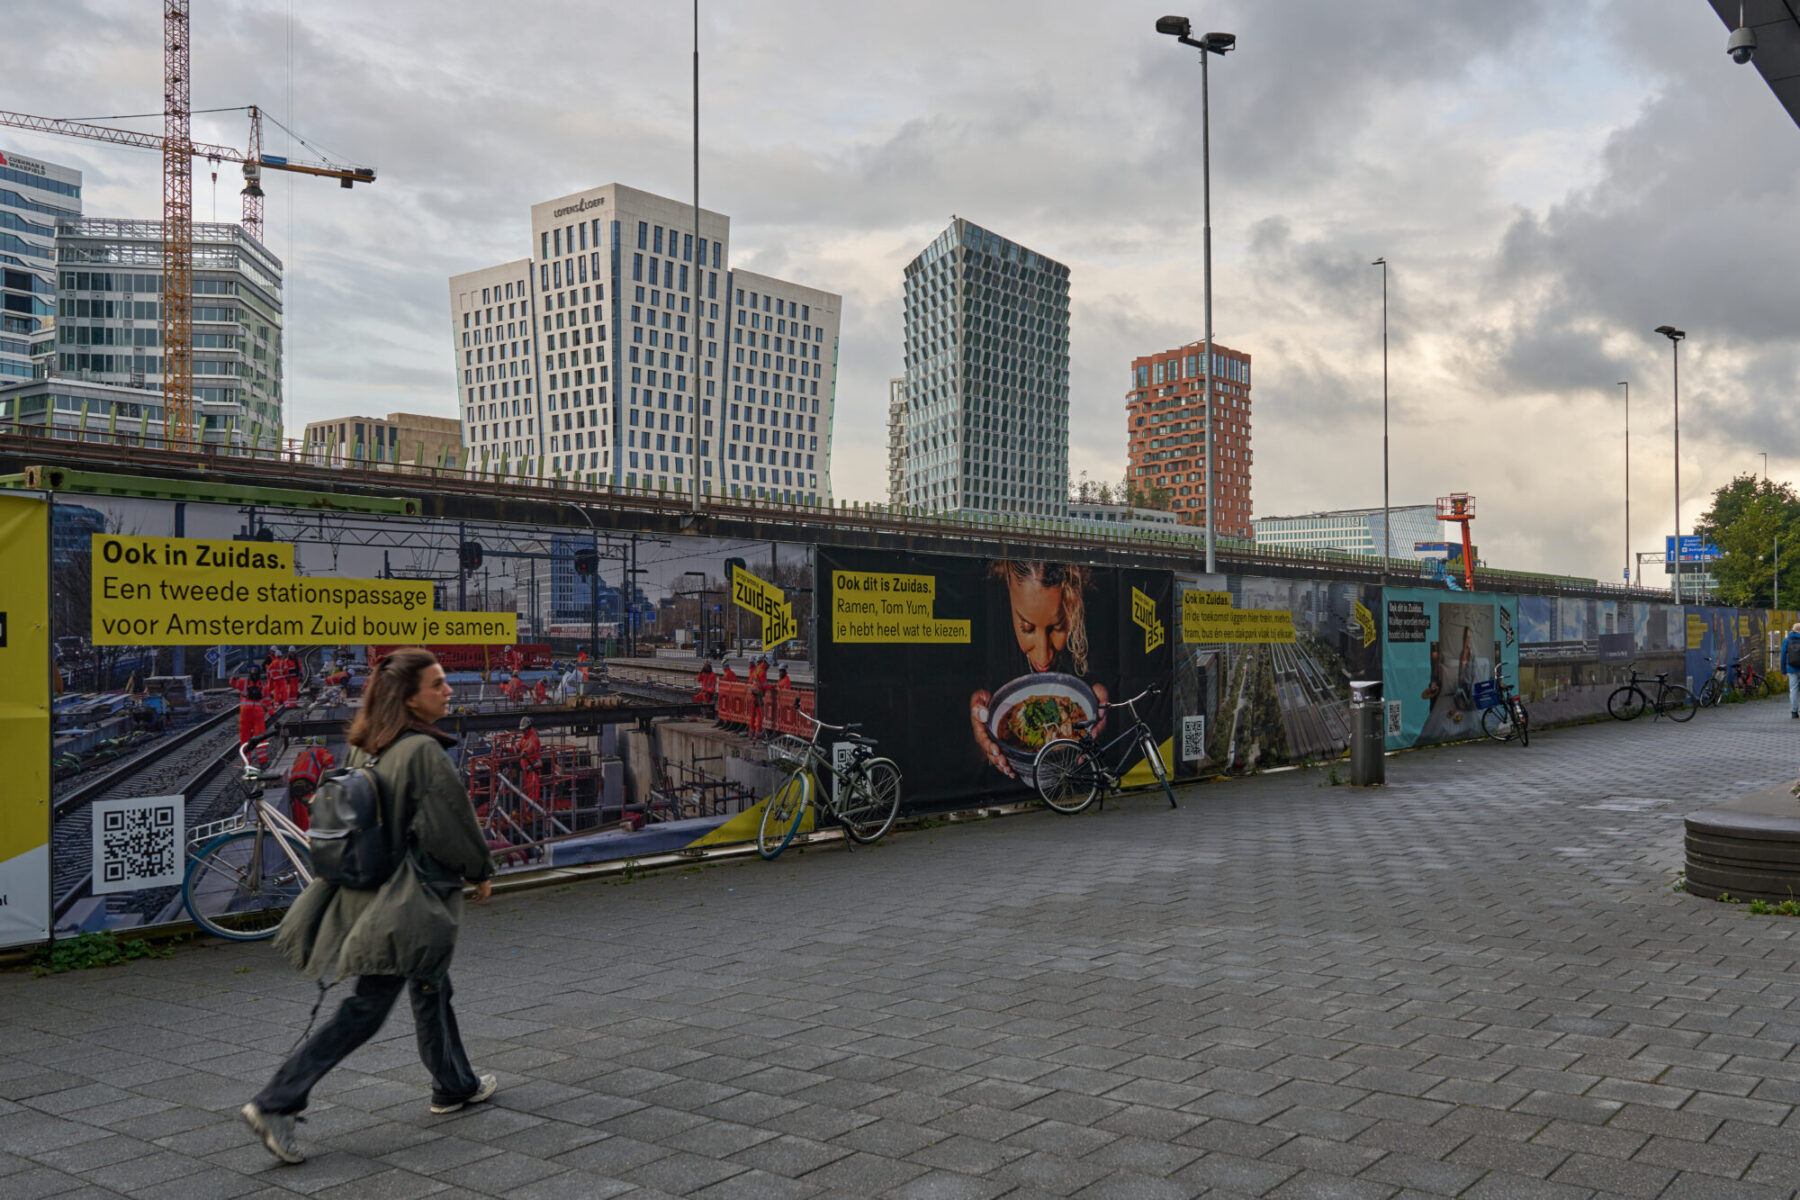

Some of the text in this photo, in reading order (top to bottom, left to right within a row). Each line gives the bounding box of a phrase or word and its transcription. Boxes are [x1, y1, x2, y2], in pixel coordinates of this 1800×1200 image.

[8, 156, 40, 169] CUSHMAN
[9, 162, 46, 176] WAKEFIELD
[103, 540, 286, 570] Ook in Zuidas.
[103, 576, 427, 610] Een tweede stationspassage
[837, 575, 932, 594] Ook dit is Zuidas.
[736, 581, 781, 620] zuidas
[837, 598, 930, 617] Ramen, Tom Yum,
[1199, 594, 1205, 604] in
[102, 613, 511, 641] voor Amsterdam Zuid bouw je samen.
[836, 621, 967, 639] je hebt heel wat te kiezen.
